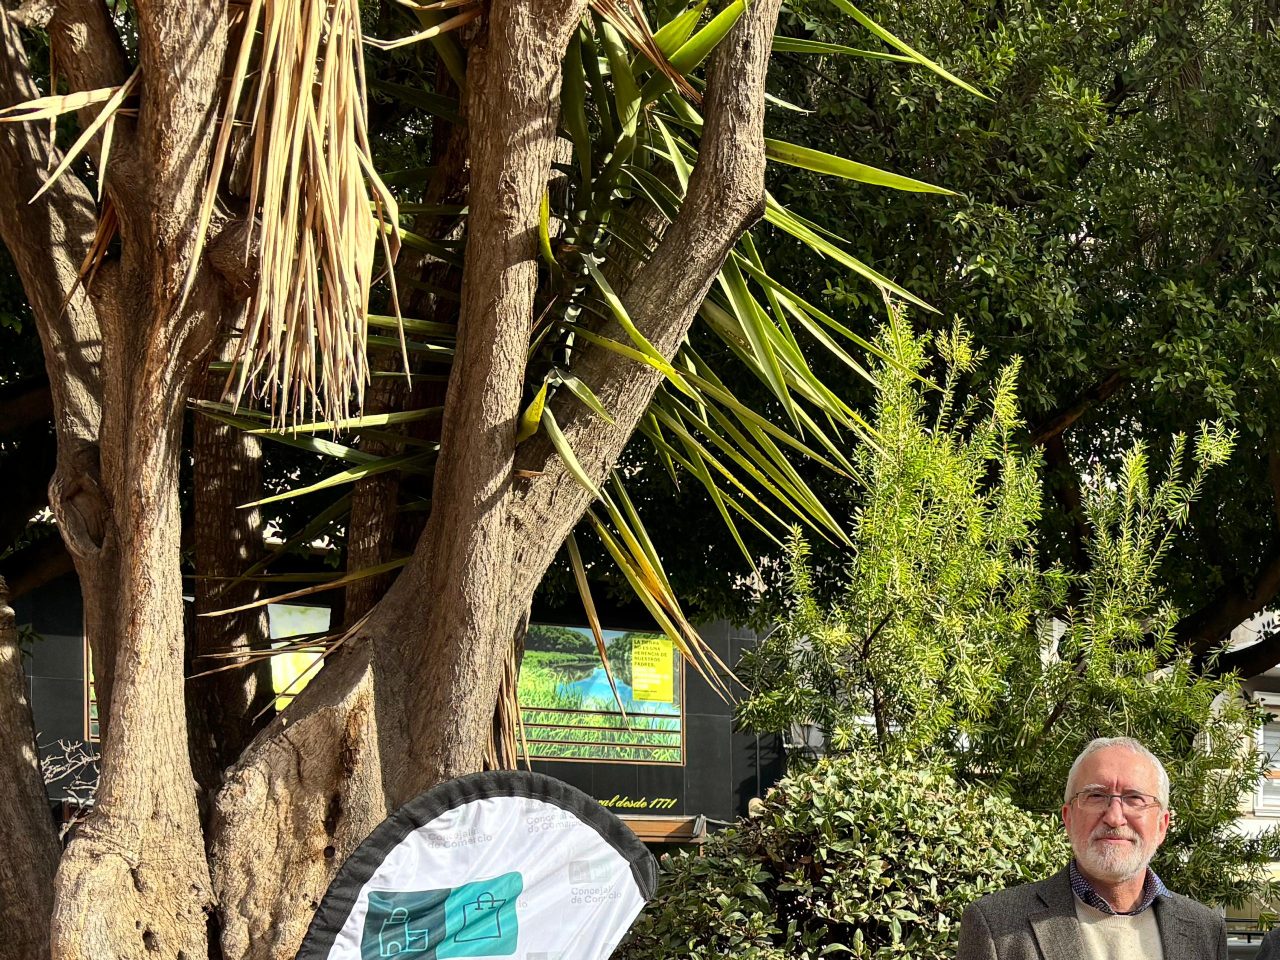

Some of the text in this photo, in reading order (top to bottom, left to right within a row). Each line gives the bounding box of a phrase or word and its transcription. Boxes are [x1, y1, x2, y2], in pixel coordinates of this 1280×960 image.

[616, 796, 648, 808] desde
[648, 797, 678, 809] 1771
[571, 896, 582, 904] de
